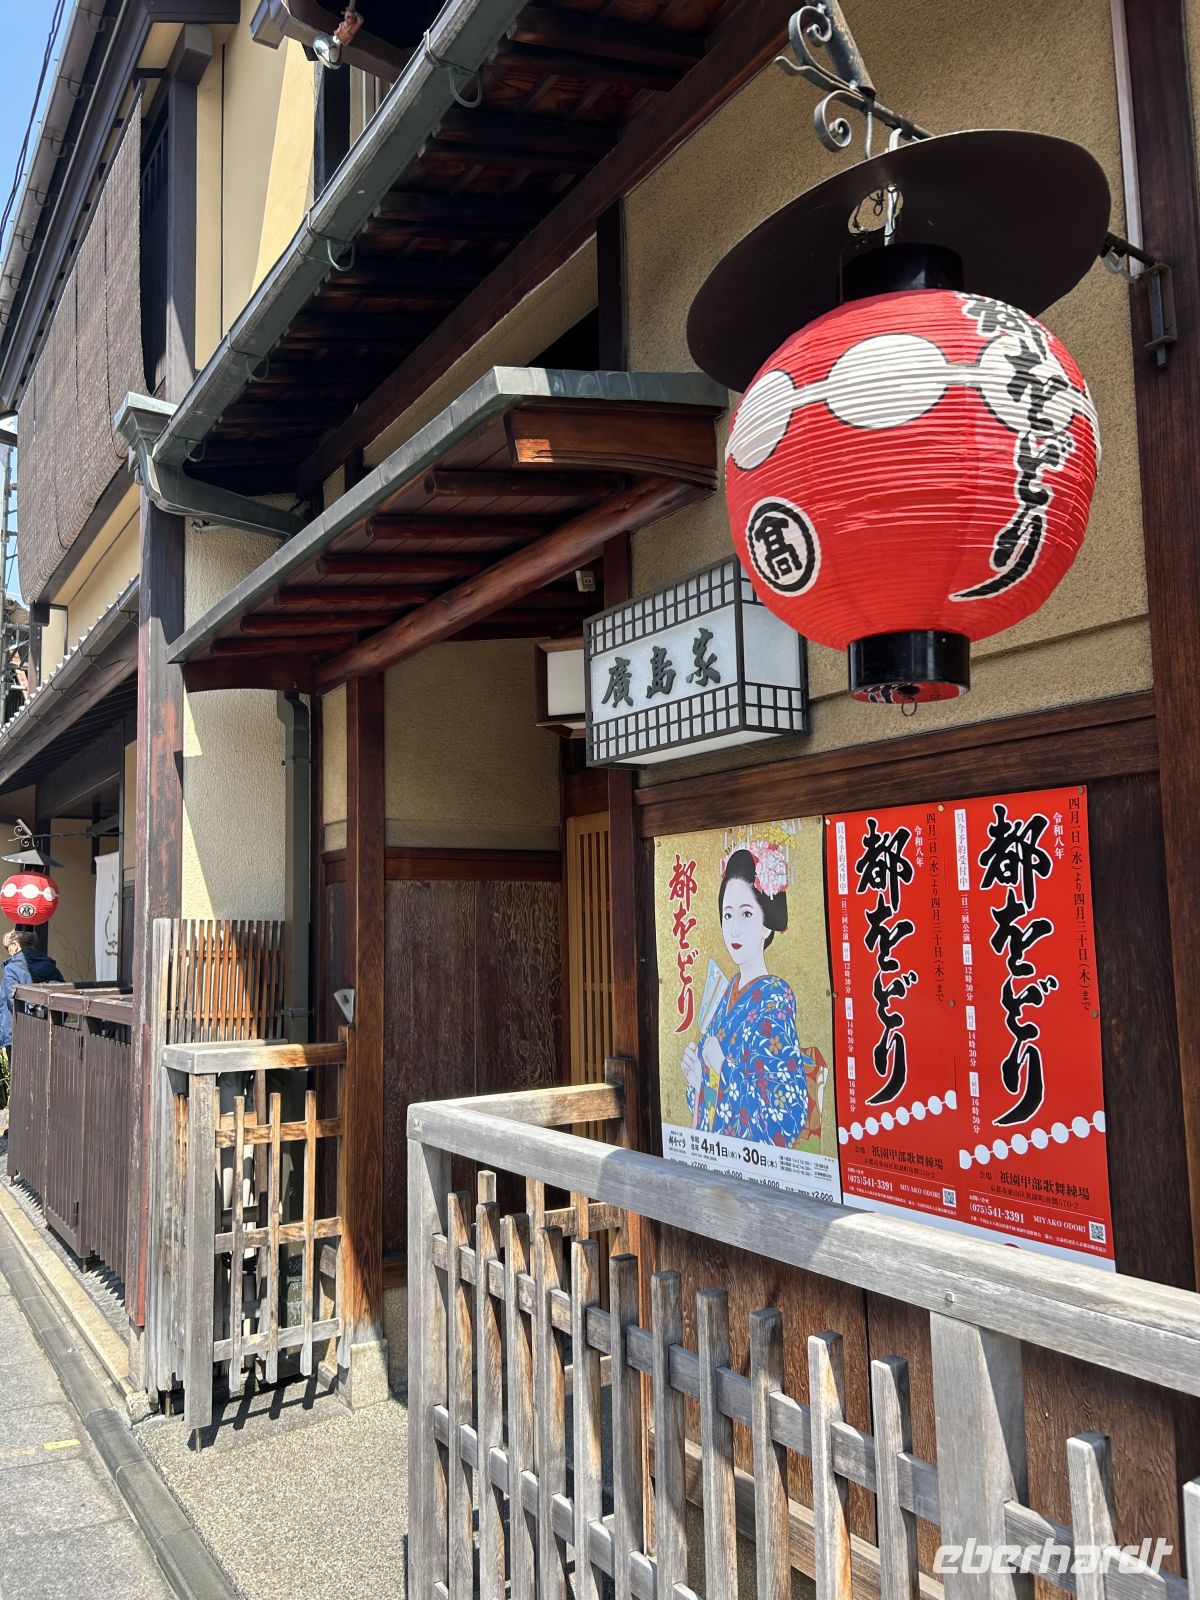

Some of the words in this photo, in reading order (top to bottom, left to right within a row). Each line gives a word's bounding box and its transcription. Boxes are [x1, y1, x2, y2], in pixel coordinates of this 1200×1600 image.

[914, 825, 924, 868] 令和八年
[1053, 812, 1065, 860] 令和八年
[668, 853, 699, 1034] 都をどり
[855, 818, 918, 1106] 都をどり
[978, 803, 1060, 1127] 都をどり
[847, 1174, 893, 1191] (075)541-3391
[899, 1183, 923, 1195] MIYAKO
[969, 1202, 1025, 1224] (075)541-3391
[1032, 1215, 1062, 1228] MIYAKO
[1063, 1221, 1086, 1233] ODORI
